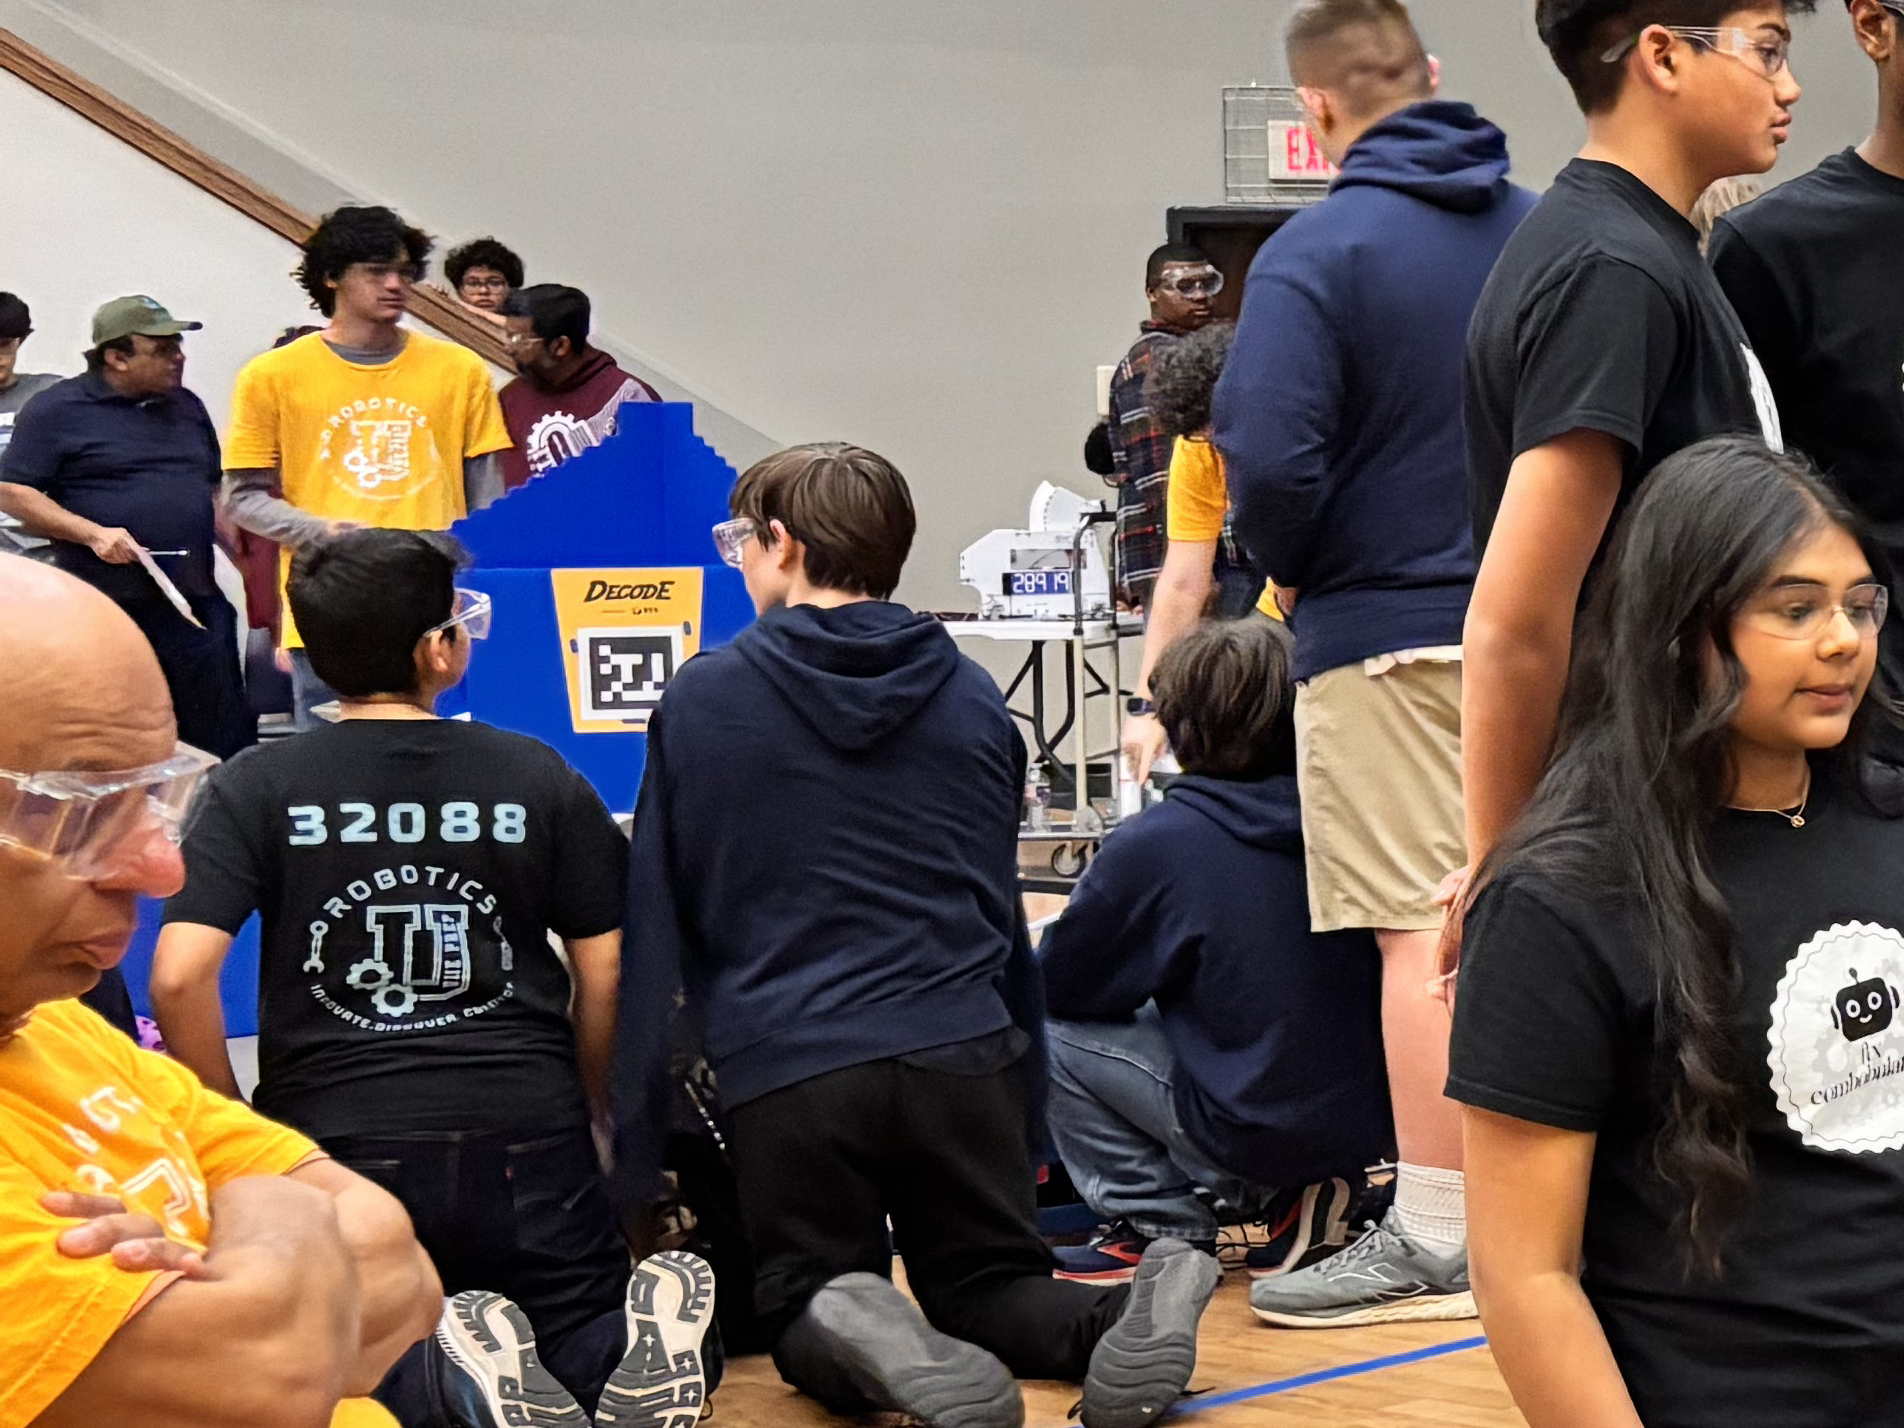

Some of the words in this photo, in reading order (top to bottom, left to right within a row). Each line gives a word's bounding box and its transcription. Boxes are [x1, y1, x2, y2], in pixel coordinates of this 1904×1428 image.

[584, 580, 675, 603] DECODE
[1012, 573, 1069, 593] 28919
[288, 801, 526, 846] 32088
[323, 864, 497, 919] ROBOTICS
